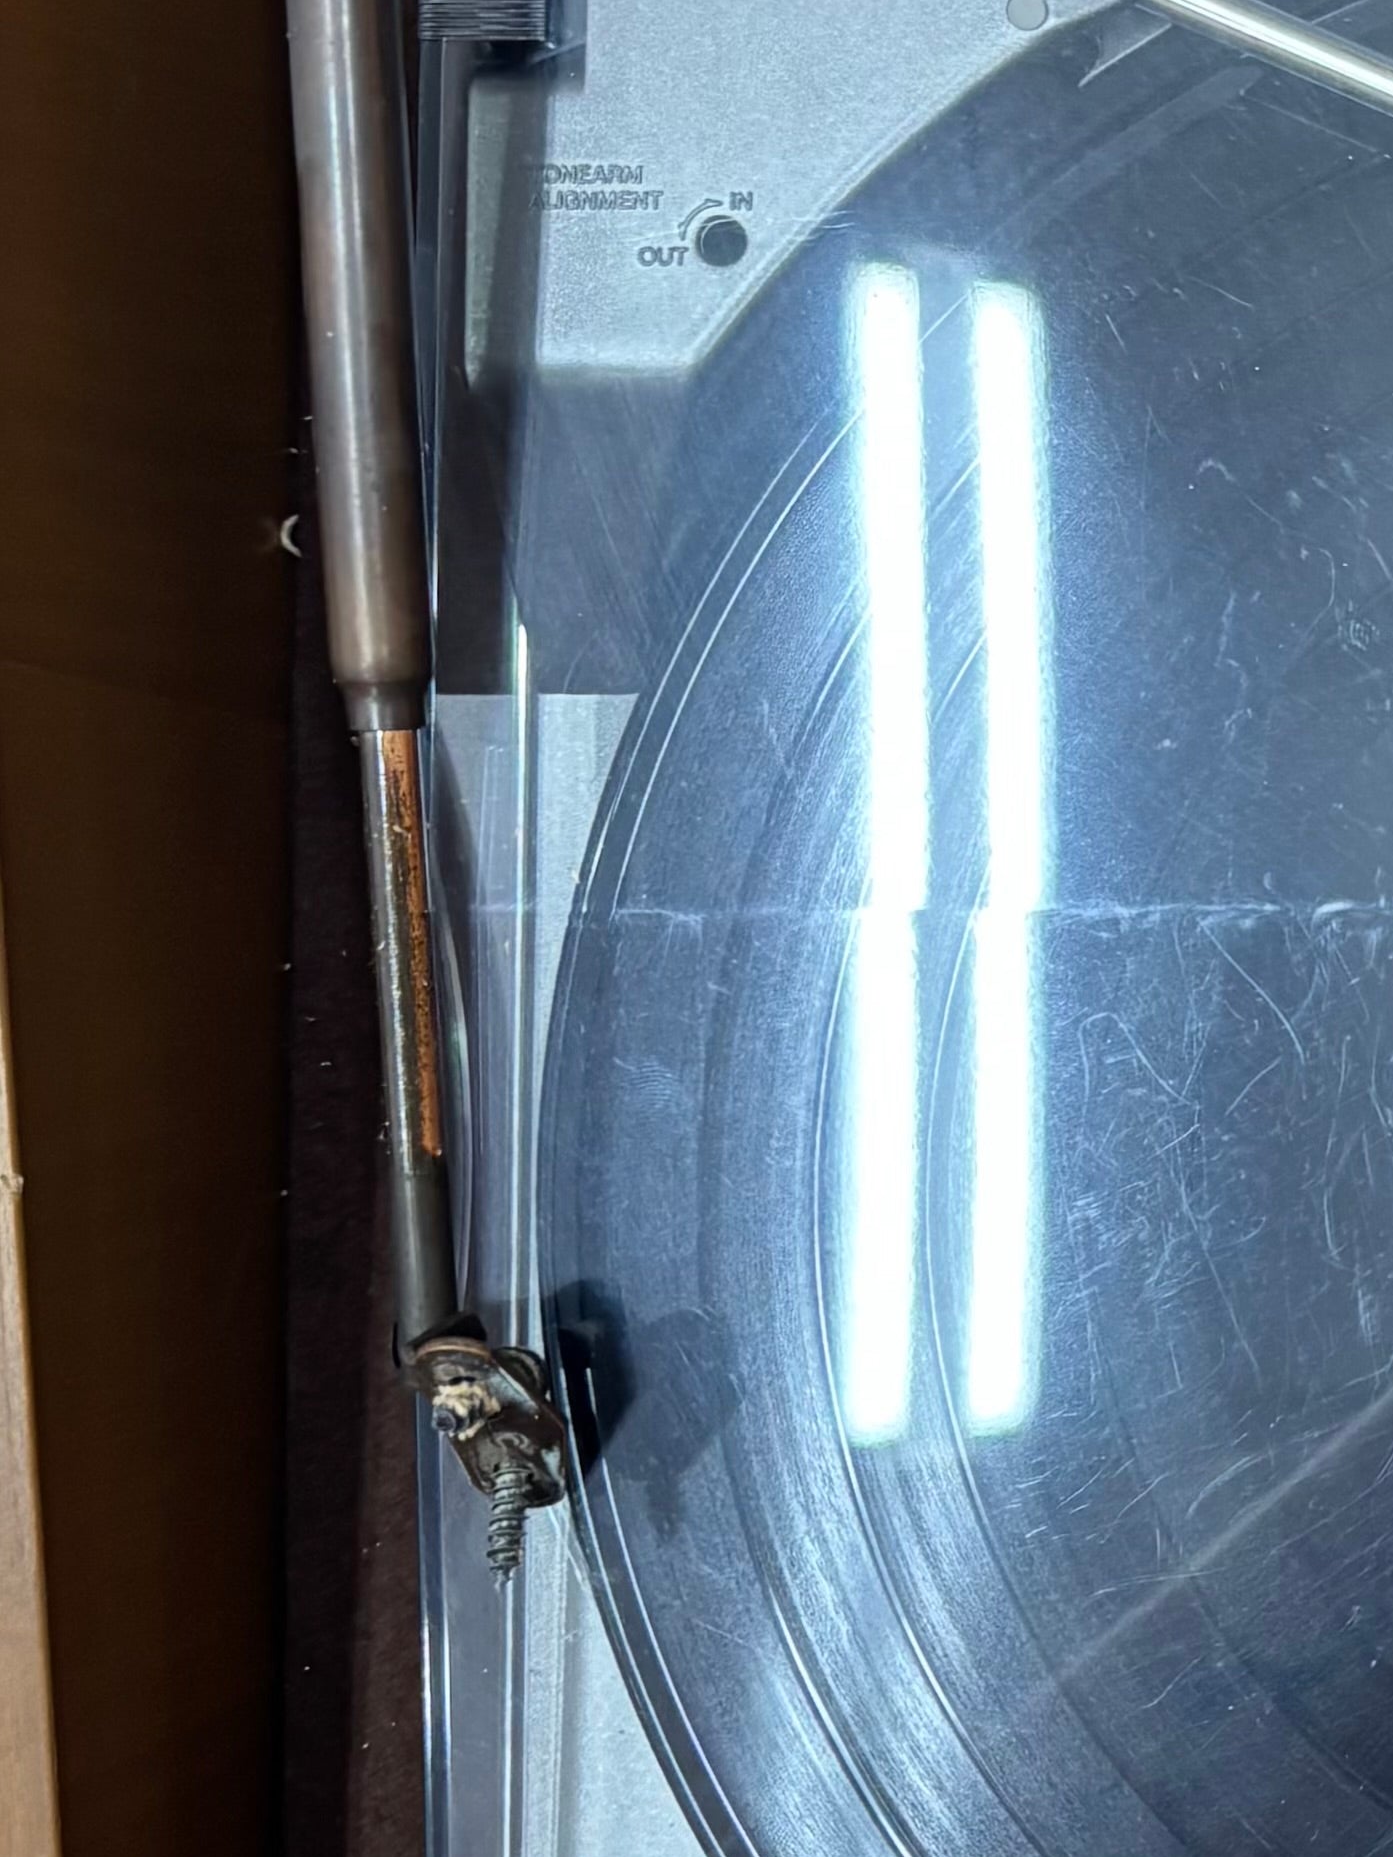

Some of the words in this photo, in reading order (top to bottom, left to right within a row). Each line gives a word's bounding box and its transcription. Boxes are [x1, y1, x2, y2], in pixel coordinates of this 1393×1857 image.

[529, 190, 663, 211] ALIGNMENT
[729, 192, 753, 211] IN
[637, 246, 688, 267] OUT
